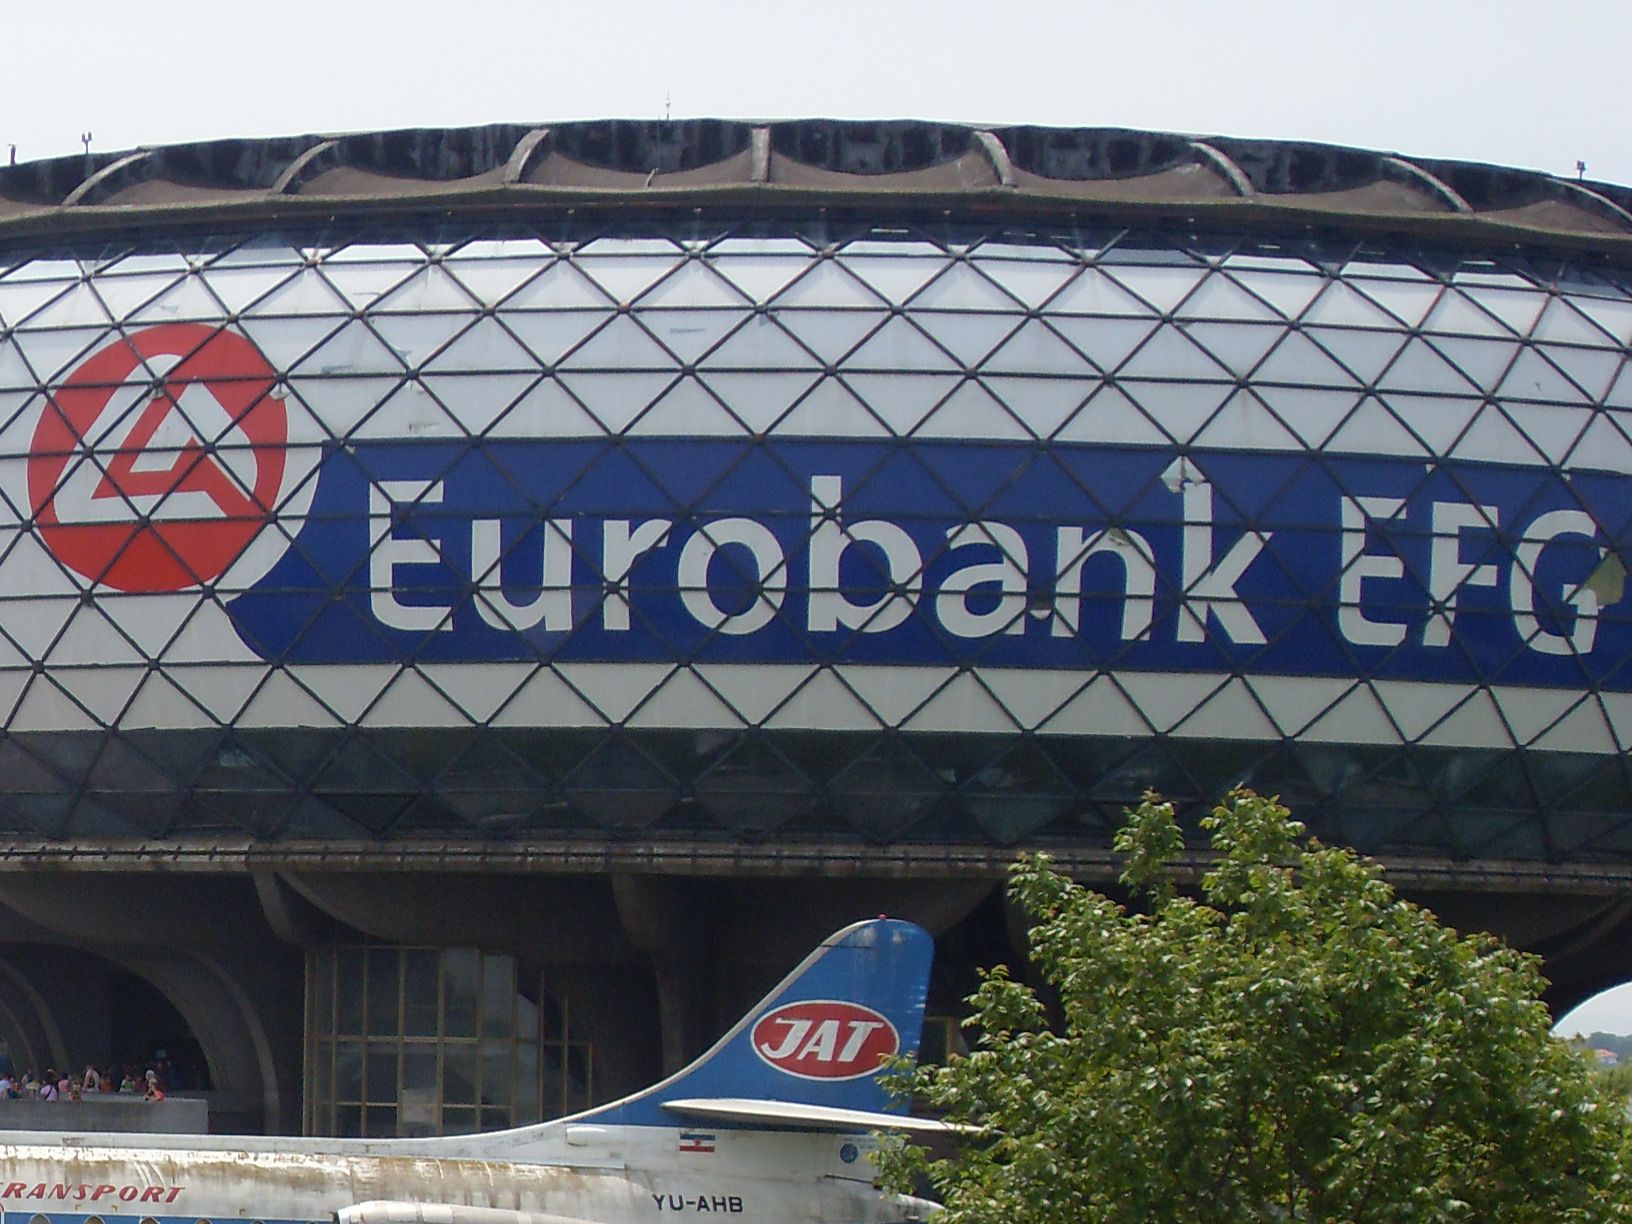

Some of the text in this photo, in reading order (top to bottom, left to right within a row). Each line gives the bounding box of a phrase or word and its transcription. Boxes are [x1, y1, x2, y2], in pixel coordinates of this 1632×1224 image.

[369, 475, 1602, 656] Eurobank EFG
[761, 1017, 885, 1062] JAT
[652, 1194, 744, 1213] YU-AHB
